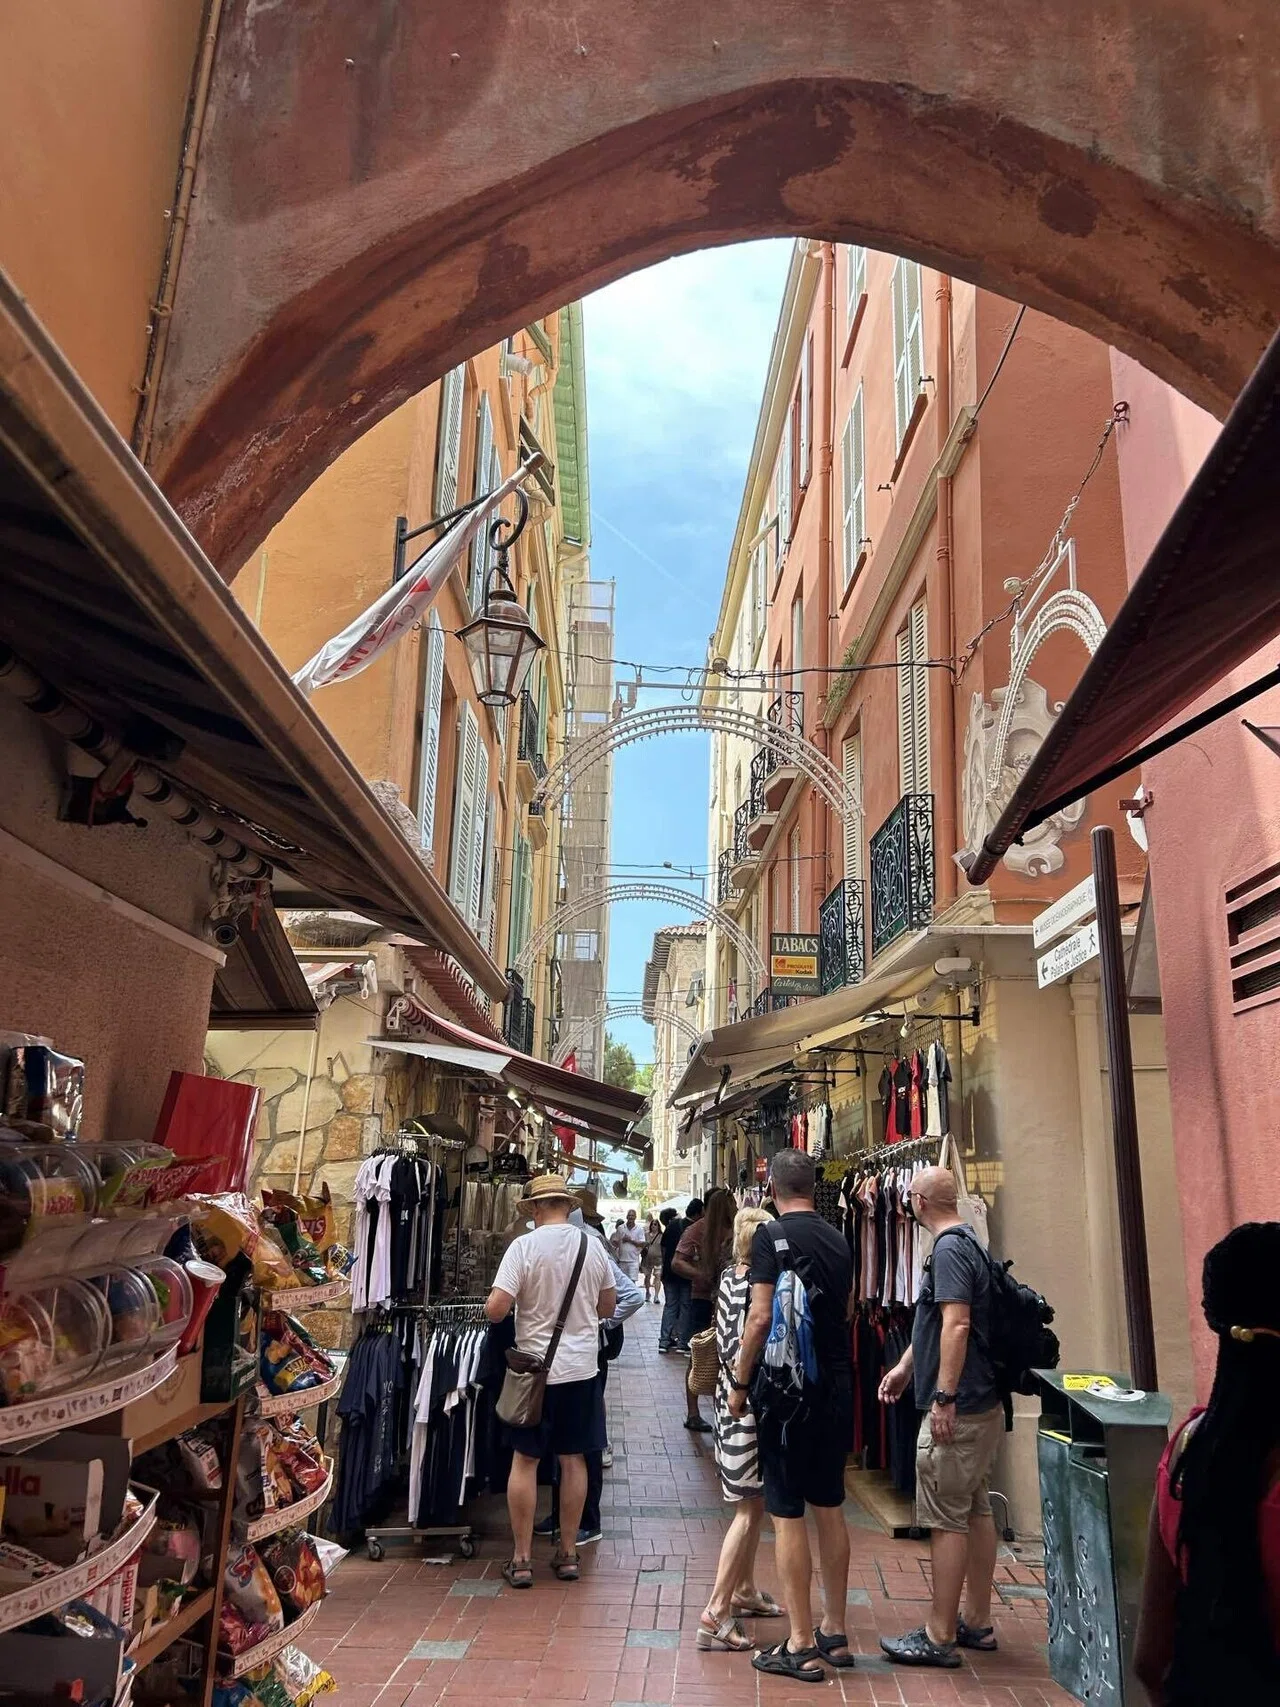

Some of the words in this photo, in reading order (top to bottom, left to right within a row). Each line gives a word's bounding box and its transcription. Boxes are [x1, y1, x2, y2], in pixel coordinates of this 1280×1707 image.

[773, 937, 819, 953] TABACS
[1064, 957, 1070, 973] de
[1070, 949, 1088, 968] Justice
[122, 1569, 135, 1618] nutella
